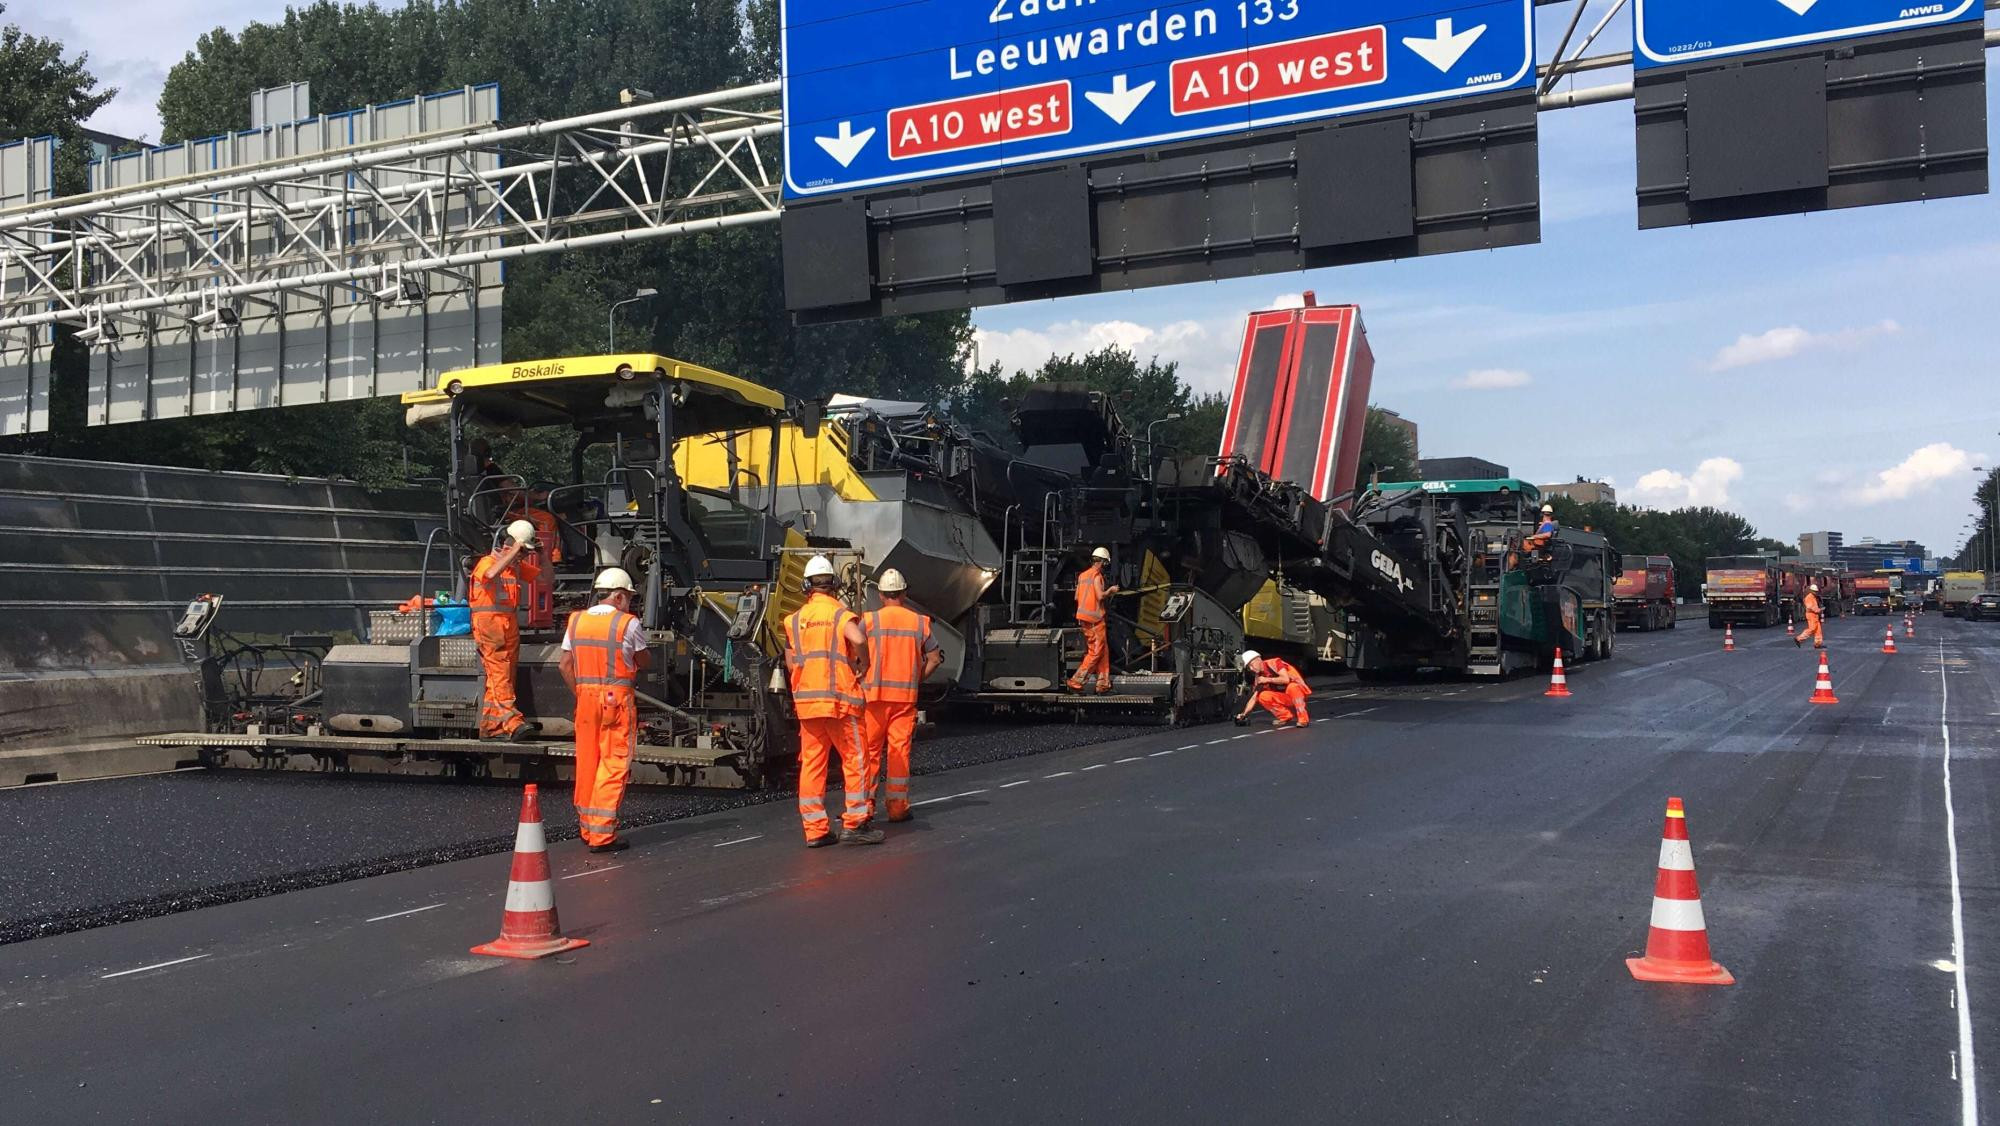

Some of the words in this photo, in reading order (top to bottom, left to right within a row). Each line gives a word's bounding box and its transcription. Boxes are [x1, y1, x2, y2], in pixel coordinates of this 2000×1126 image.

[989, 0, 1097, 23] Za
[1899, 4, 1944, 18] ANWB
[950, 8, 1217, 81] Leeuwarden
[1237, 0, 1299, 29] 133
[1669, 41, 1713, 53] 10222/013
[1183, 61, 1260, 102] A10
[1278, 41, 1373, 86] west
[1466, 72, 1502, 85] ANWB
[899, 111, 964, 148] A10
[979, 94, 1061, 134] west
[511, 363, 565, 379] Boskalis
